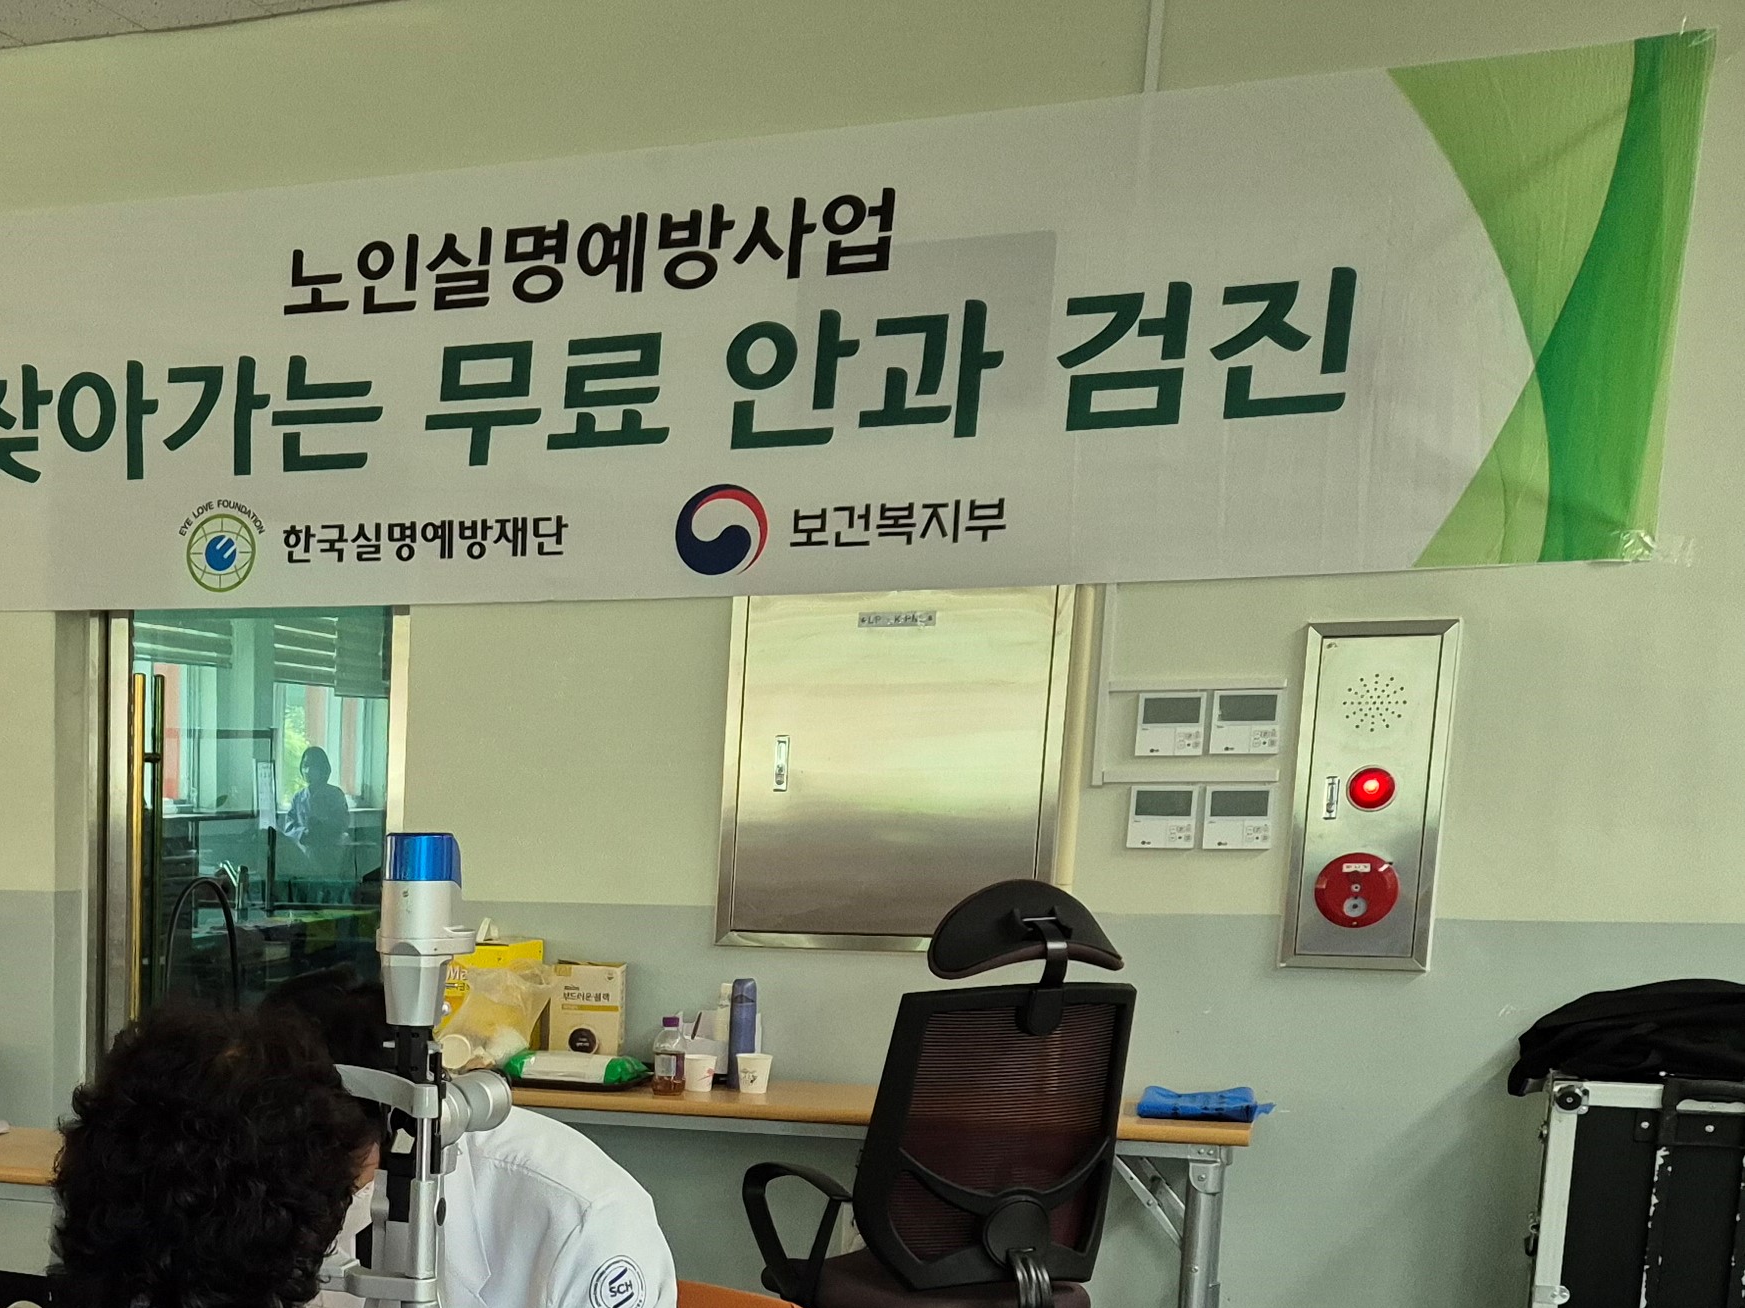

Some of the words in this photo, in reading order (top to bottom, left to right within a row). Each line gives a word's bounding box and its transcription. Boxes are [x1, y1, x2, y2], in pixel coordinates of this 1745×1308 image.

[284, 186, 896, 318] 노인실명예방사업
[425, 331, 671, 466] 무료
[726, 300, 1005, 450] 안과
[1057, 266, 1358, 432] 검진
[178, 517, 194, 537] EYE
[192, 501, 215, 519] LOVE
[217, 499, 266, 535] FOUNDATION
[282, 515, 569, 564] 한국실명예방재단
[790, 498, 1007, 548] 보건복지부
[609, 1279, 633, 1298] SCH
